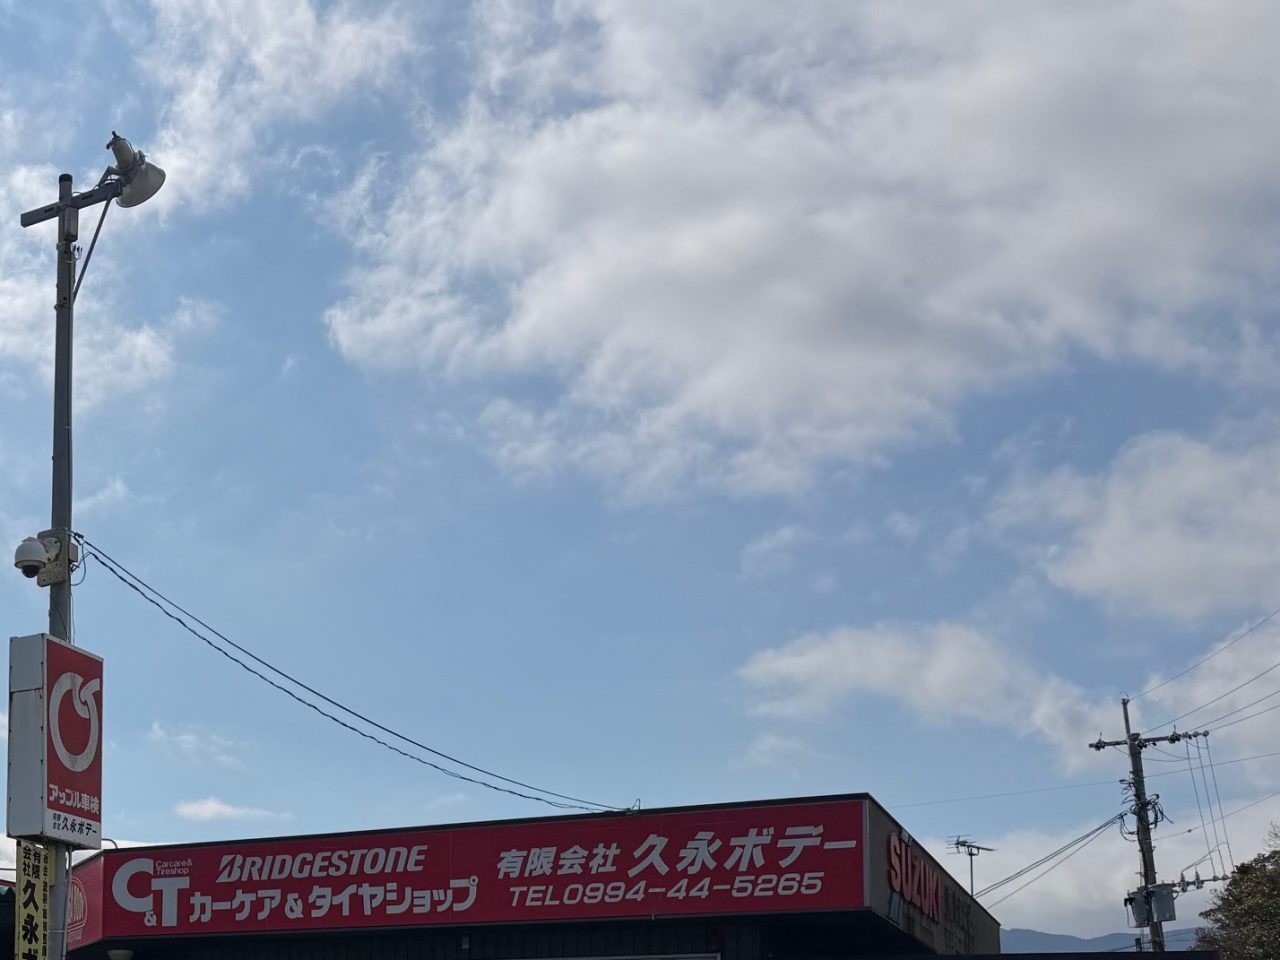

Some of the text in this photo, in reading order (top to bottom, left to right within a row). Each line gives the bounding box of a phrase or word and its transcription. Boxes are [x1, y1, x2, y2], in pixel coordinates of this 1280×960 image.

[62, 817, 97, 836] 久永ボデー
[216, 845, 428, 883] BRIDGESTONE
[496, 825, 857, 879] 有限会社 久永ボデー
[189, 876, 478, 922] カーケア&タイヤショップ
[509, 872, 824, 907] TEL0994-44-5265
[888, 832, 945, 925] SUZUKI
